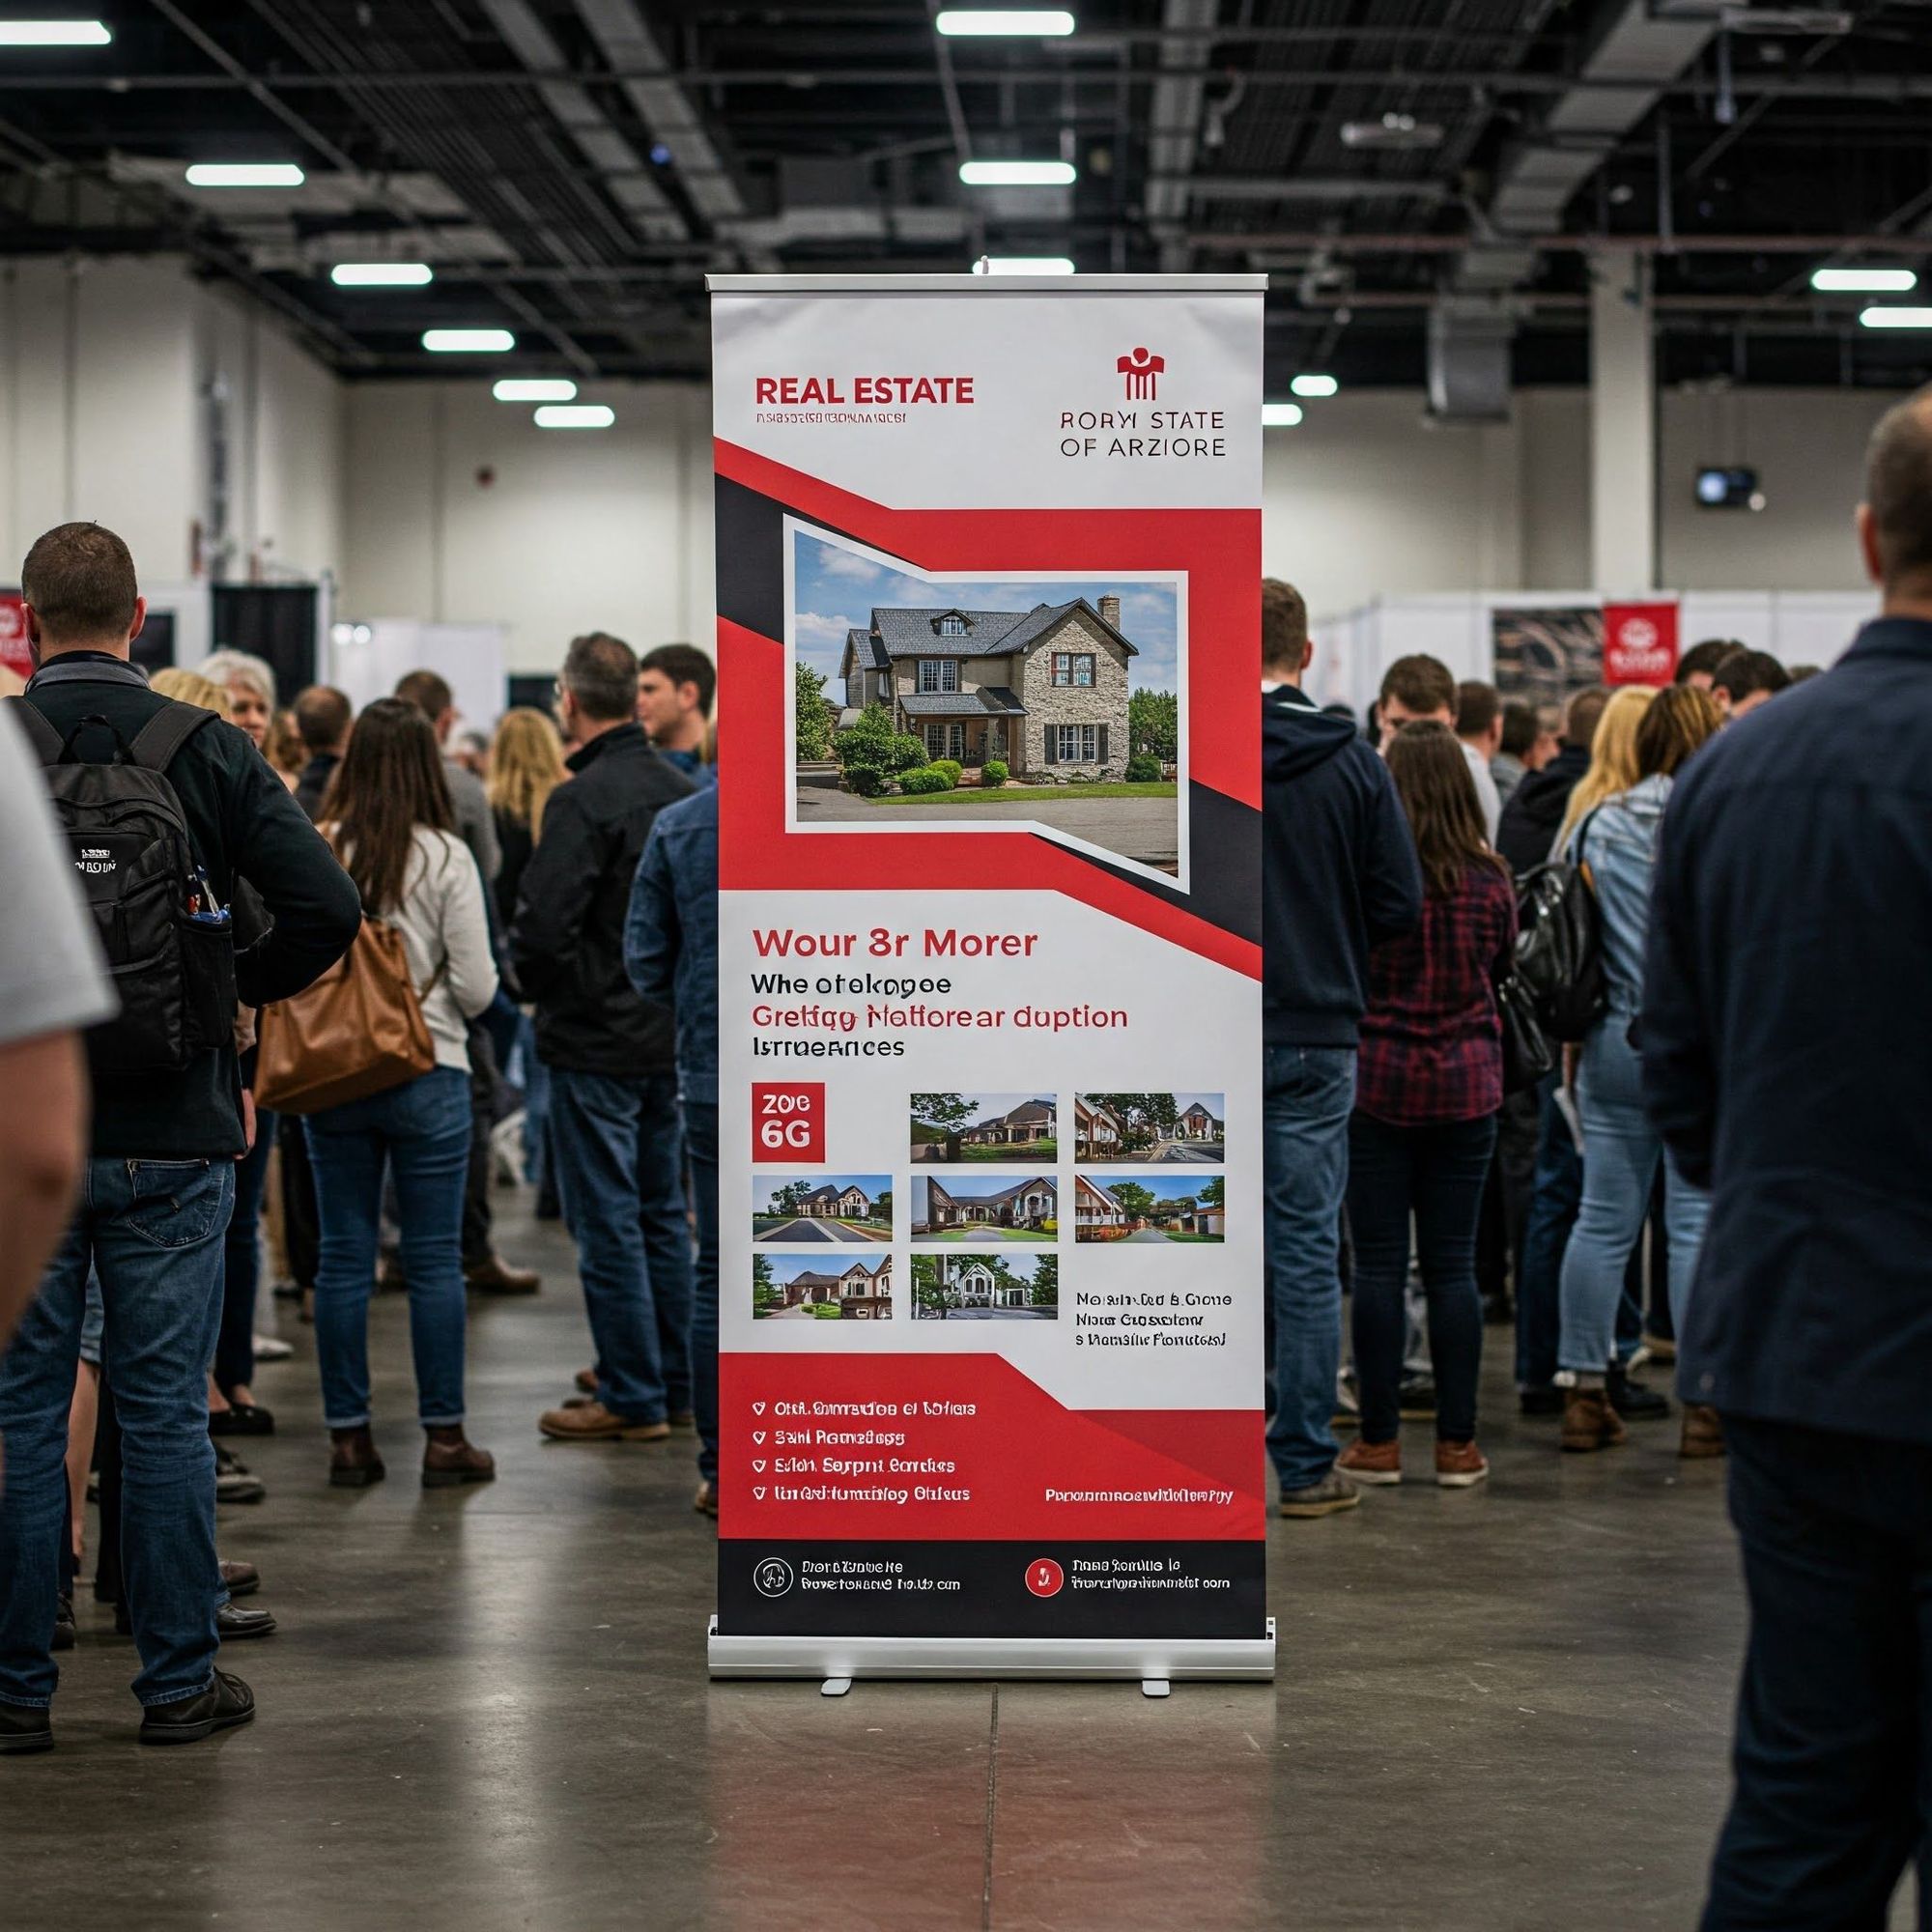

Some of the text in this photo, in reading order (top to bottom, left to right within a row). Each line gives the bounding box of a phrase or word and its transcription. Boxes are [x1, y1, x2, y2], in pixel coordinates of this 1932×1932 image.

[756, 378, 975, 404] REAL ESTATE
[1151, 412, 1225, 429] STATE
[1061, 438, 1227, 457] OF ARZIORE
[753, 928, 857, 957] Wour
[923, 928, 1038, 957] Morer
[760, 1119, 810, 1149] 6G
